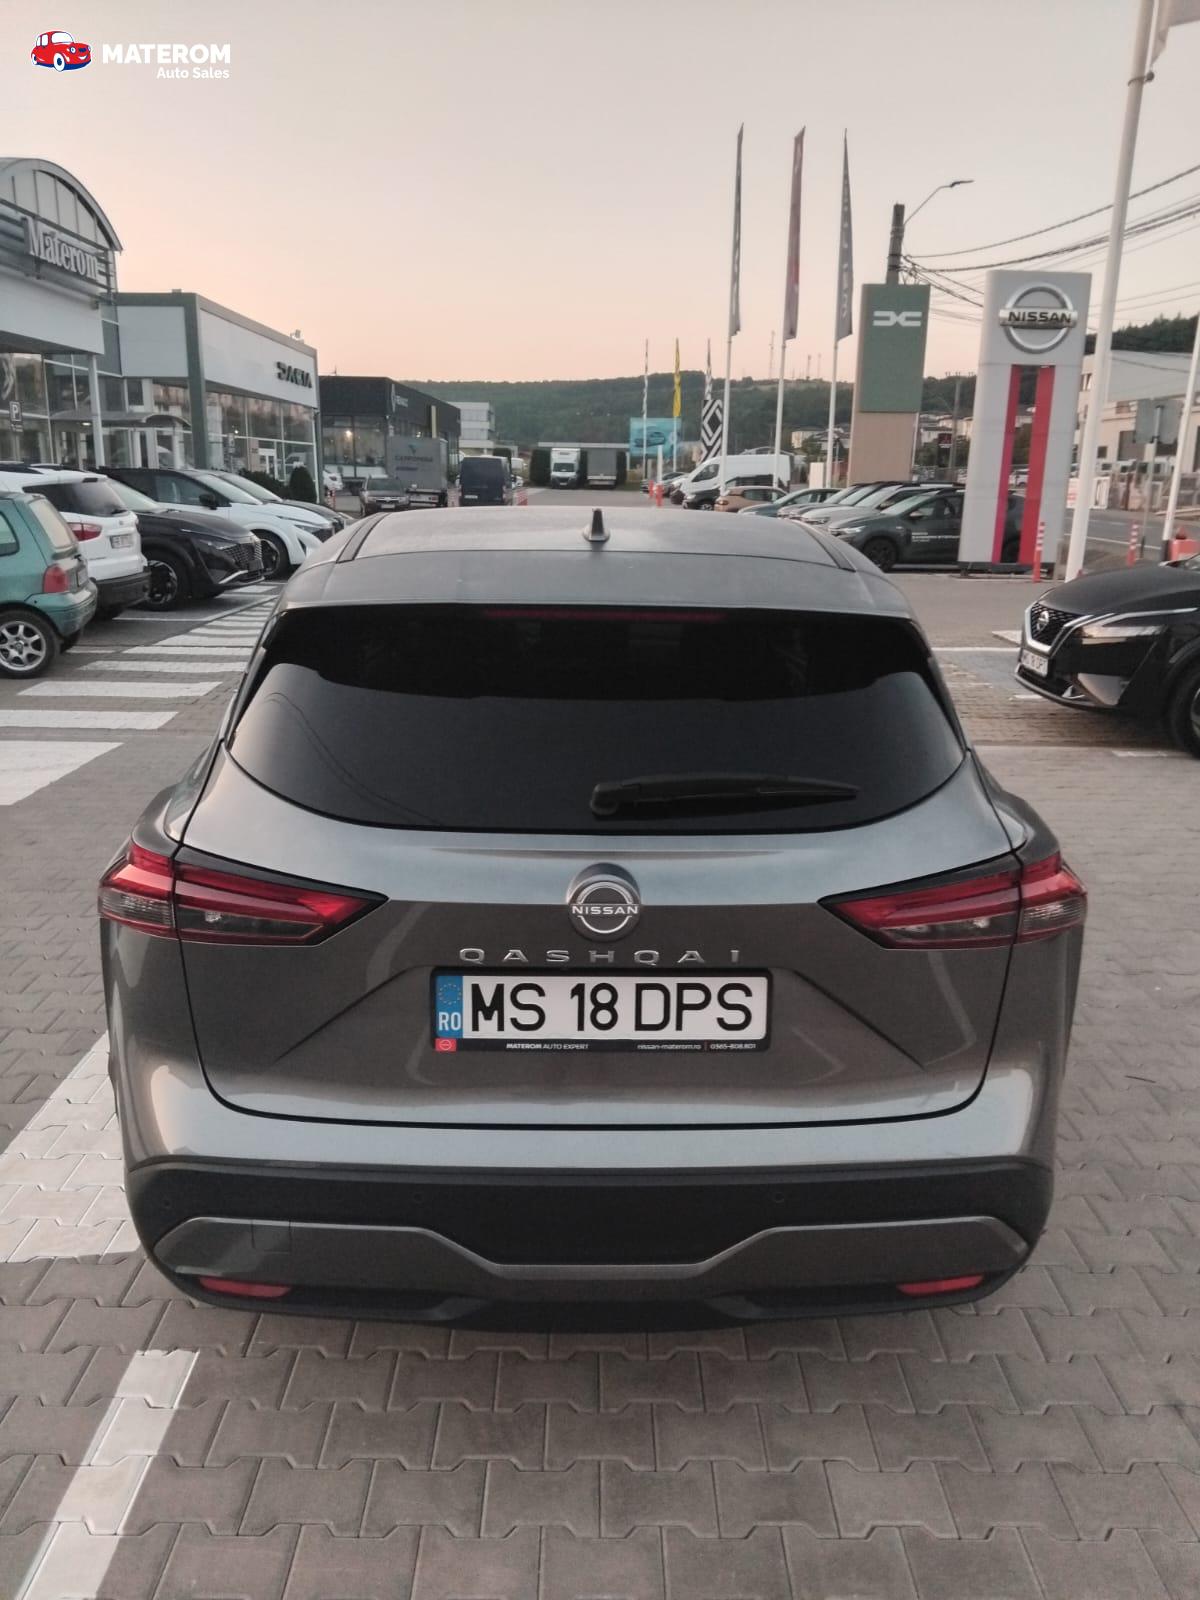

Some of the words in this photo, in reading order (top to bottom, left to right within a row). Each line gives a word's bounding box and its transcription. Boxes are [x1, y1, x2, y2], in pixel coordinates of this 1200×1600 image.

[26, 216, 98, 280] Materom
[1008, 311, 1072, 323] NISSAN
[12, 404, 19, 419] P
[571, 905, 639, 915] NISSAN
[459, 947, 740, 966] QASHQAI
[471, 983, 546, 1032] MS
[570, 982, 619, 1032] 18
[634, 982, 753, 1032] DPS
[438, 1011, 462, 1031] RO
[506, 1042, 542, 1050] MATEROM
[543, 1042, 562, 1050] AUTO
[563, 1042, 589, 1050] EXPERT
